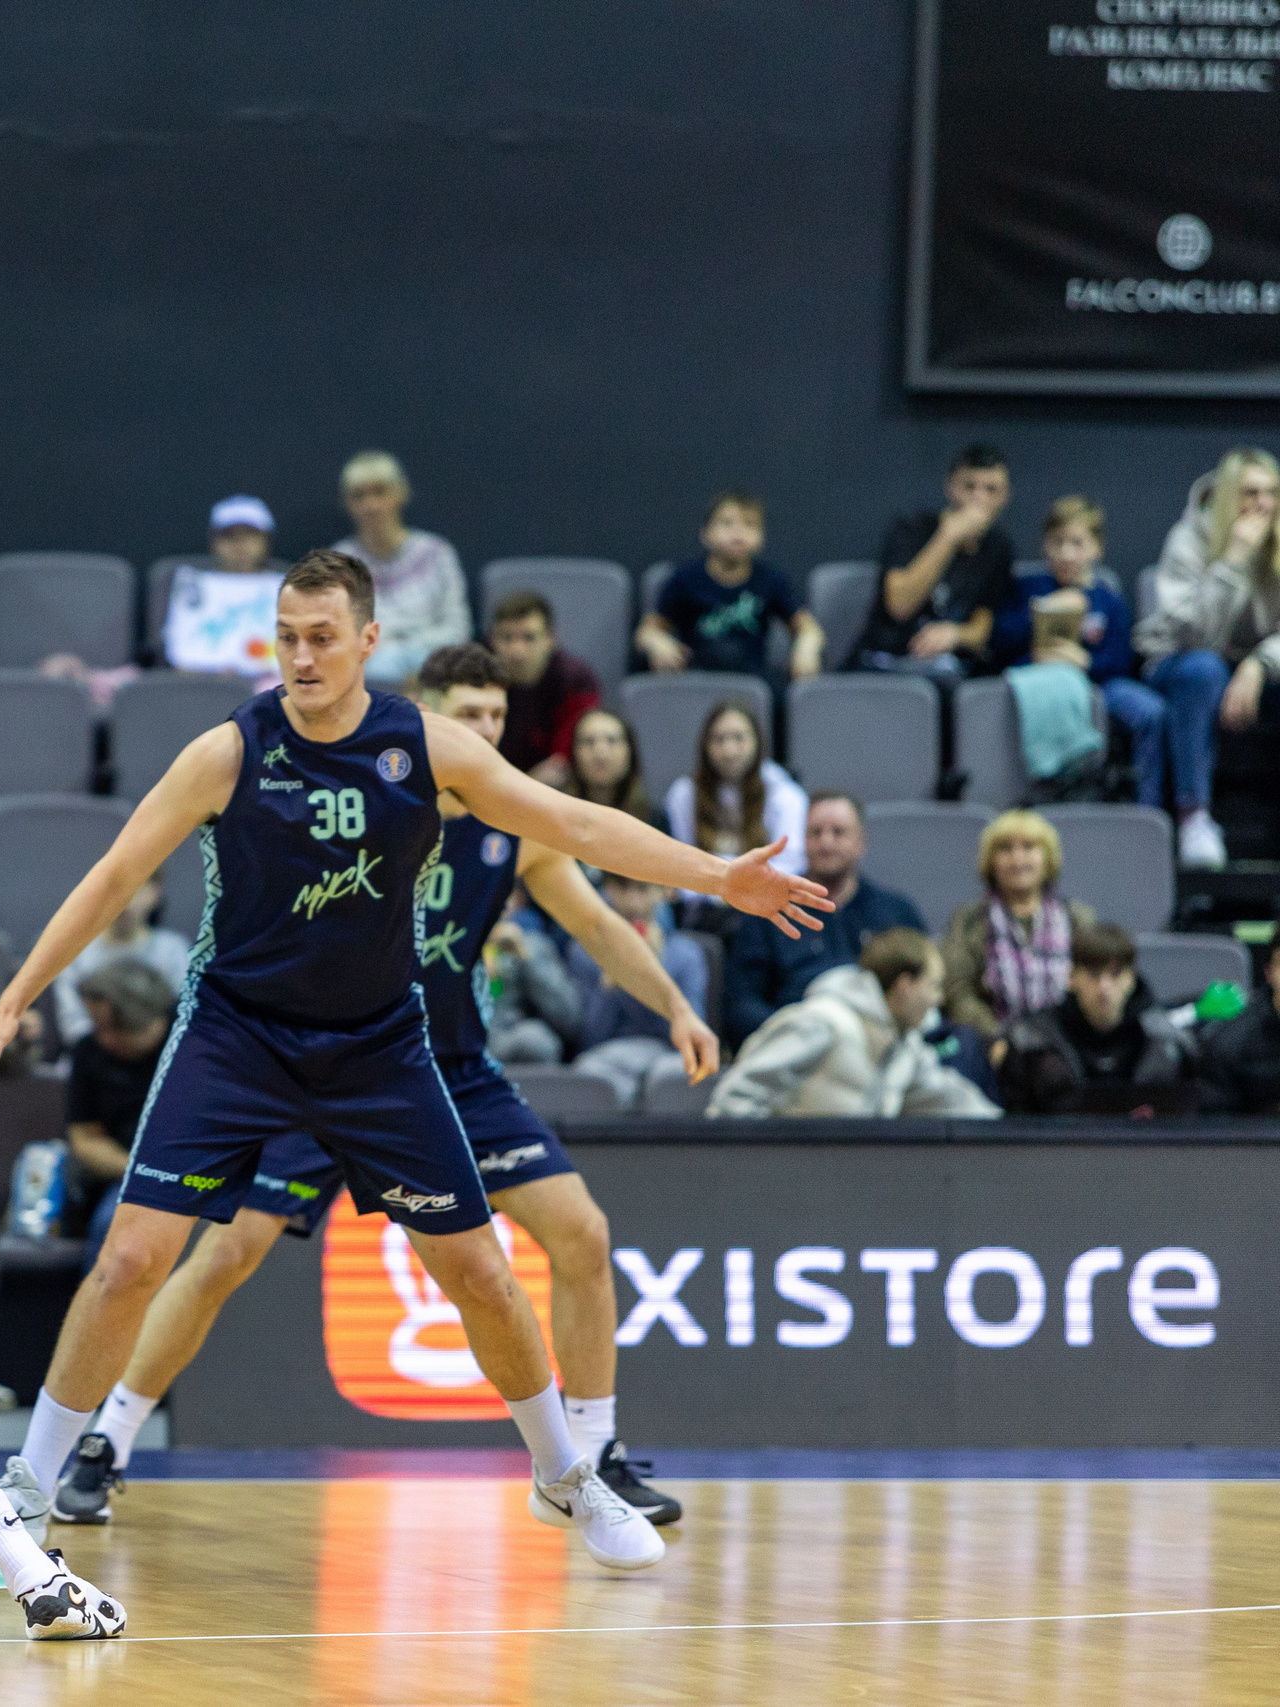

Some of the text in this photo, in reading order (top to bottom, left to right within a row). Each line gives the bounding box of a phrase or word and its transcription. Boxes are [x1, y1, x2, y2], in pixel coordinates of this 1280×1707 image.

[259, 778, 304, 793] Kempa
[307, 787, 366, 840] 38
[134, 1163, 180, 1183] Kempa
